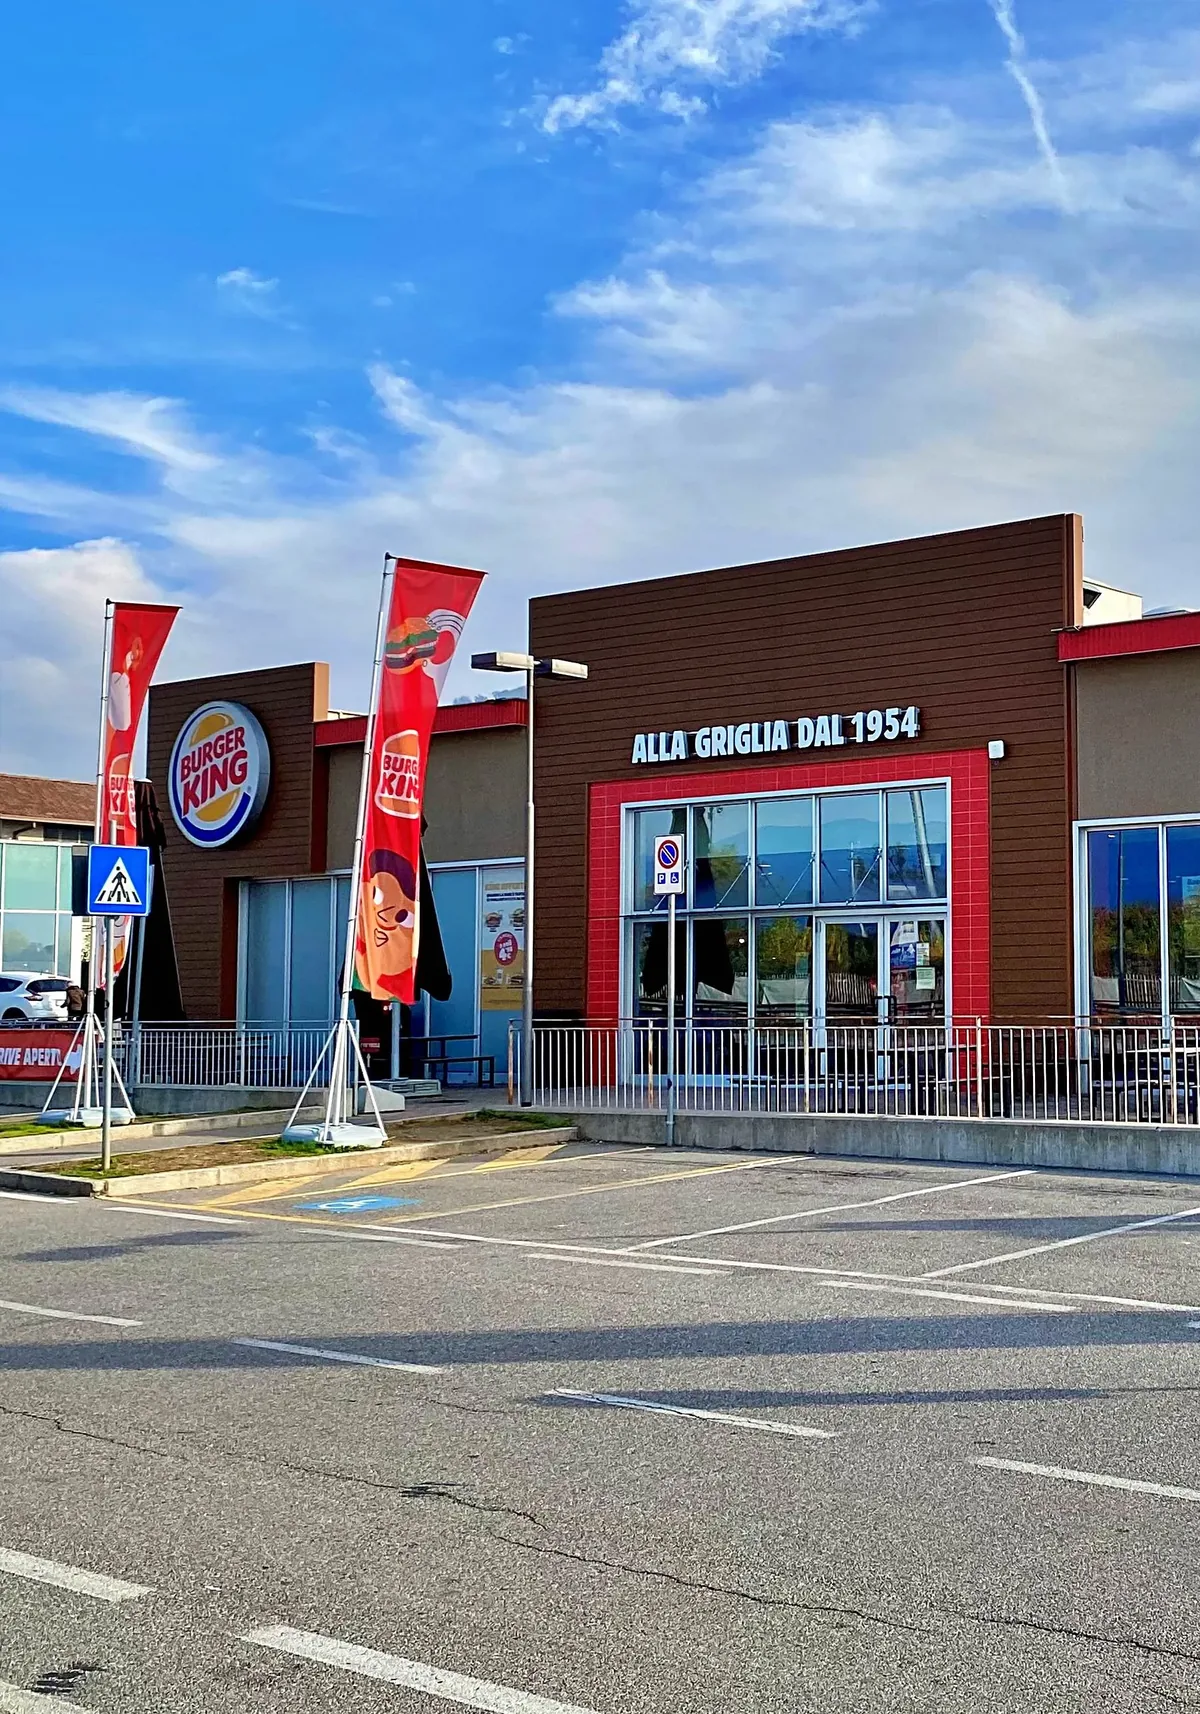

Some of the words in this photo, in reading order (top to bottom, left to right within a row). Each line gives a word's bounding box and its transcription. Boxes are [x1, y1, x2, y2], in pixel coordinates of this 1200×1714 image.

[181, 726, 246, 783] BURGER
[631, 731, 688, 764] ALLA
[694, 720, 789, 759] GRIGLIA
[797, 714, 845, 749] DAL
[850, 706, 919, 743] 1954
[182, 749, 248, 817] KING
[380, 772, 420, 799] KIN
[383, 754, 418, 775] BURG
[0, 1047, 22, 1066] RIVE
